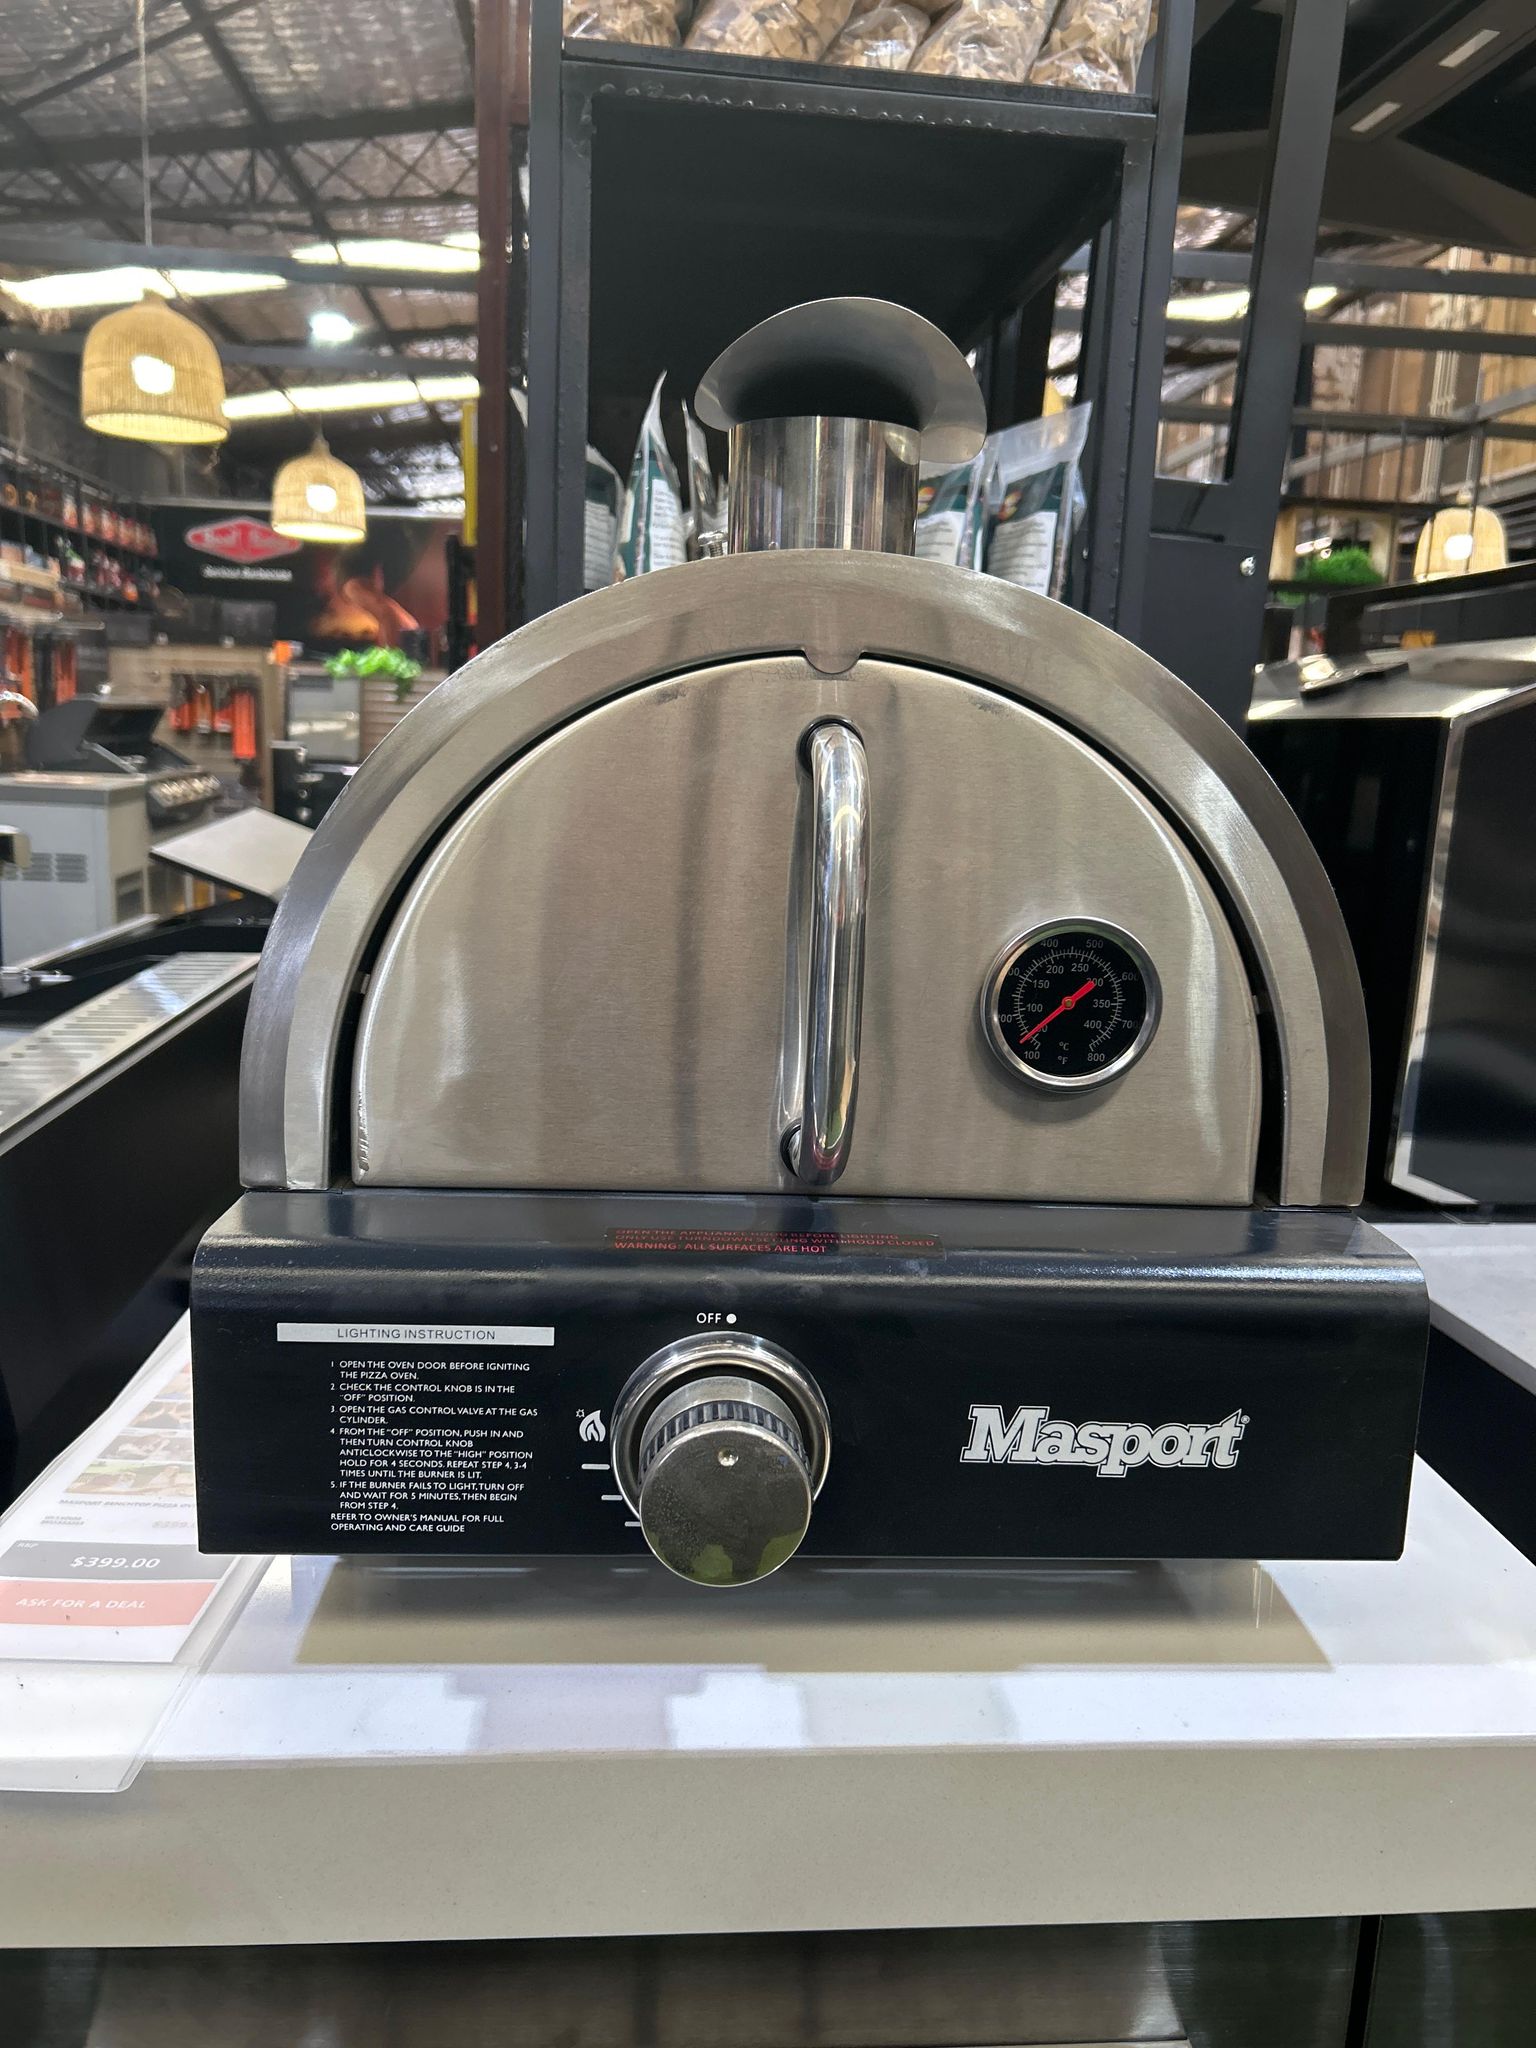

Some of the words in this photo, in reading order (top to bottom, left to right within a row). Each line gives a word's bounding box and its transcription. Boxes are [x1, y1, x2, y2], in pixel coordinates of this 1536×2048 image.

[1040, 939, 1059, 948] 400
[1086, 939, 1104, 949] 500
[1008, 967, 1020, 976] 00
[1046, 965, 1064, 975] 200
[1071, 963, 1089, 972] 250
[1033, 979, 1050, 989] 150
[1026, 1003, 1043, 1013] 100
[1093, 1000, 1111, 1009] 350
[999, 1014, 1013, 1023] 00
[1084, 1020, 1102, 1029] 400
[1023, 1051, 1040, 1061] 100
[1087, 1053, 1106, 1062] 800
[614, 1242, 680, 1250] WARNING:
[708, 1243, 772, 1251] SURFACES
[801, 1245, 827, 1253] HOT
[696, 1312, 722, 1324] OFF
[337, 1328, 401, 1339] LIGHTING
[404, 1329, 495, 1340] INSTRUCTION
[366, 1361, 385, 1369] THE
[388, 1361, 415, 1369] OVEN
[417, 1361, 447, 1370] DOOR
[449, 1362, 484, 1370] BEFORE
[486, 1362, 530, 1371] IGNITING
[340, 1371, 358, 1379] THE
[360, 1371, 388, 1379] PIZZA
[390, 1372, 420, 1380] OVEN.
[339, 1383, 372, 1391] CHECK
[394, 1384, 442, 1392] CONTROL
[444, 1384, 472, 1393] KNOB
[474, 1385, 483, 1393] IS
[484, 1385, 495, 1393] IN
[496, 1385, 516, 1393] THE
[368, 1394, 415, 1402] POSITION.
[387, 1406, 407, 1414] GAS
[409, 1406, 456, 1415] CONTROL
[456, 1407, 484, 1415] VALVE
[498, 1408, 517, 1416] THE
[519, 1408, 538, 1416] GAS
[339, 1416, 388, 1424] CYLINDER.
[339, 1428, 365, 1436] FROM
[366, 1428, 385, 1436] THE
[463, 1429, 487, 1438] PUSH
[490, 1430, 500, 1438] IN
[501, 1430, 524, 1438] AND
[340, 1438, 365, 1446] THEN
[366, 1439, 394, 1447] TURN
[396, 1439, 443, 1447] CONTROL
[445, 1440, 474, 1448] KNOB
[960, 1404, 1246, 1477] Masport
[339, 1449, 418, 1457] ANTICLOCKWISE
[419, 1450, 433, 1458] TO
[434, 1450, 453, 1458] THE
[454, 1450, 487, 1458] “HIGH”
[488, 1451, 533, 1459] POSITION
[339, 1459, 367, 1467] HOLD
[369, 1459, 388, 1467] FOR
[447, 1461, 479, 1469] REPEAT
[481, 1461, 502, 1469] STEP
[340, 1469, 365, 1477] TIMES
[367, 1470, 396, 1478] UNTIL
[397, 1470, 416, 1478] THE
[418, 1470, 455, 1479] BURNER
[457, 1471, 466, 1479] IS
[339, 1481, 347, 1489] IF
[348, 1481, 366, 1489] THE
[369, 1482, 406, 1490] BURNER
[408, 1482, 432, 1490] FAILS
[432, 1482, 447, 1490] TO
[478, 1483, 505, 1491] TURN
[507, 1483, 525, 1491] OFF
[362, 1492, 387, 1500] WAIT
[390, 1492, 408, 1500] FOR
[411, 1492, 416, 1500] 5
[461, 1493, 487, 1501] THEN
[489, 1493, 518, 1501] BEGIN
[339, 1502, 365, 1510] FROM
[367, 1502, 389, 1510] STEP
[330, 1513, 357, 1521] REFER
[358, 1513, 372, 1521] TO
[374, 1514, 417, 1522] OWNER'S
[419, 1514, 460, 1522] MANUAL
[462, 1514, 480, 1522] FOR
[483, 1515, 505, 1523] FULL
[330, 1523, 383, 1531] OPERATING
[384, 1524, 407, 1532] AND
[409, 1524, 434, 1532] CARE
[435, 1524, 465, 1532] GUIDE
[70, 1556, 161, 1569] $399.00
[15, 1598, 50, 1606] ASK
[52, 1599, 86, 1608] FOR
[88, 1600, 102, 1608] A
[105, 1600, 147, 1609] DEAL
